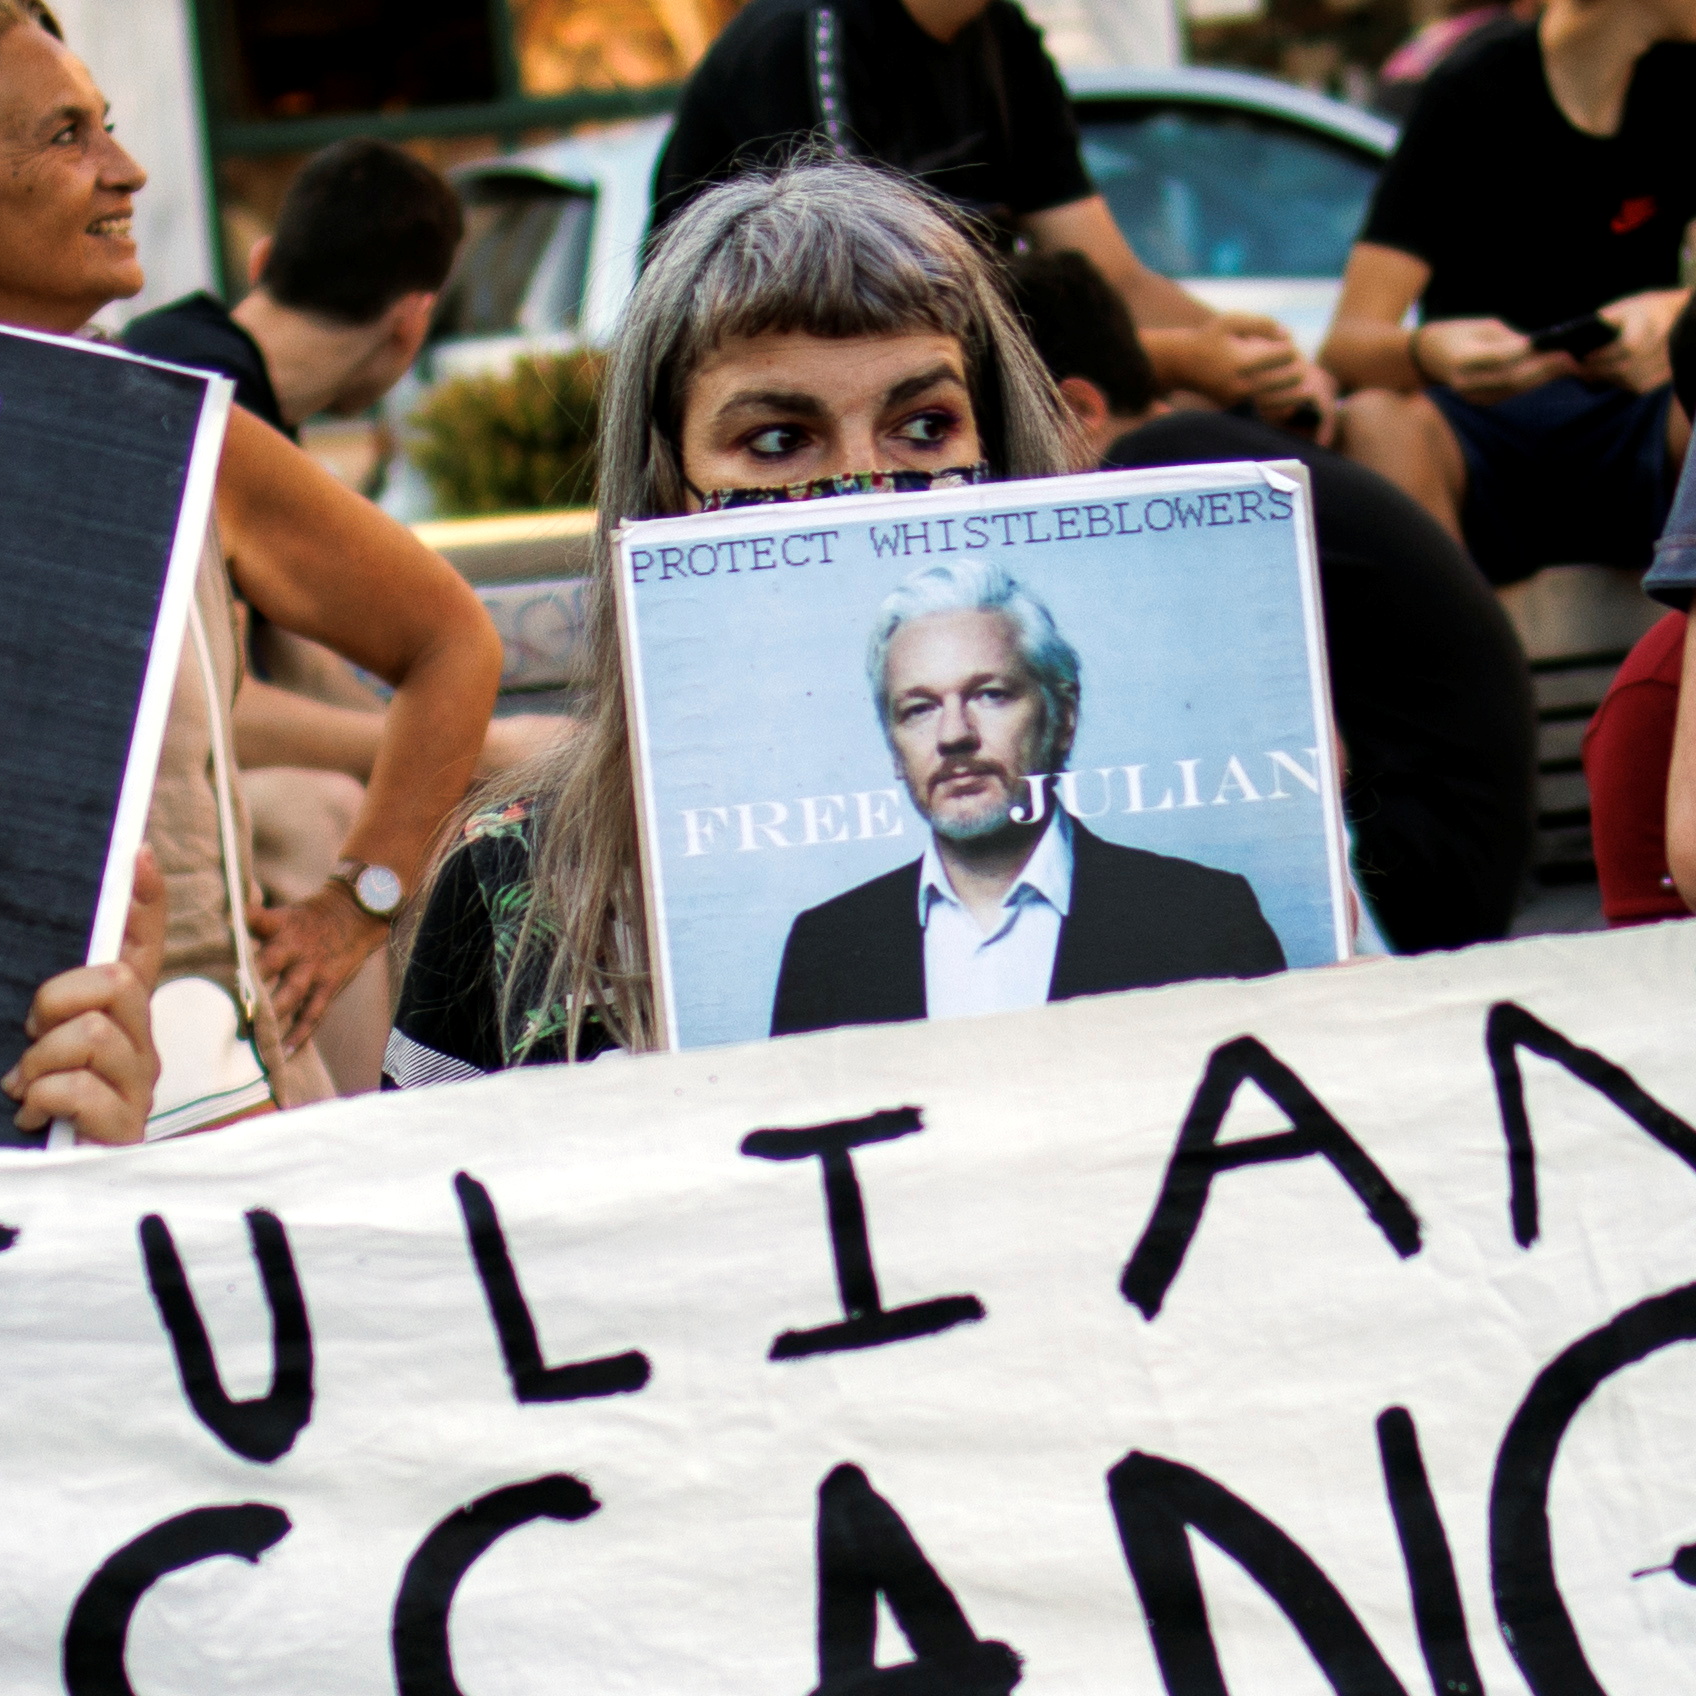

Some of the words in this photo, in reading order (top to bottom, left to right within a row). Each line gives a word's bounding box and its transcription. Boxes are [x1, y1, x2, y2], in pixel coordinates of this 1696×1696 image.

[632, 531, 839, 583] PROTECT
[870, 489, 1294, 559] WHISTLEBLOWERS
[680, 787, 905, 858] FREE
[1009, 747, 1321, 825] JULIAN
